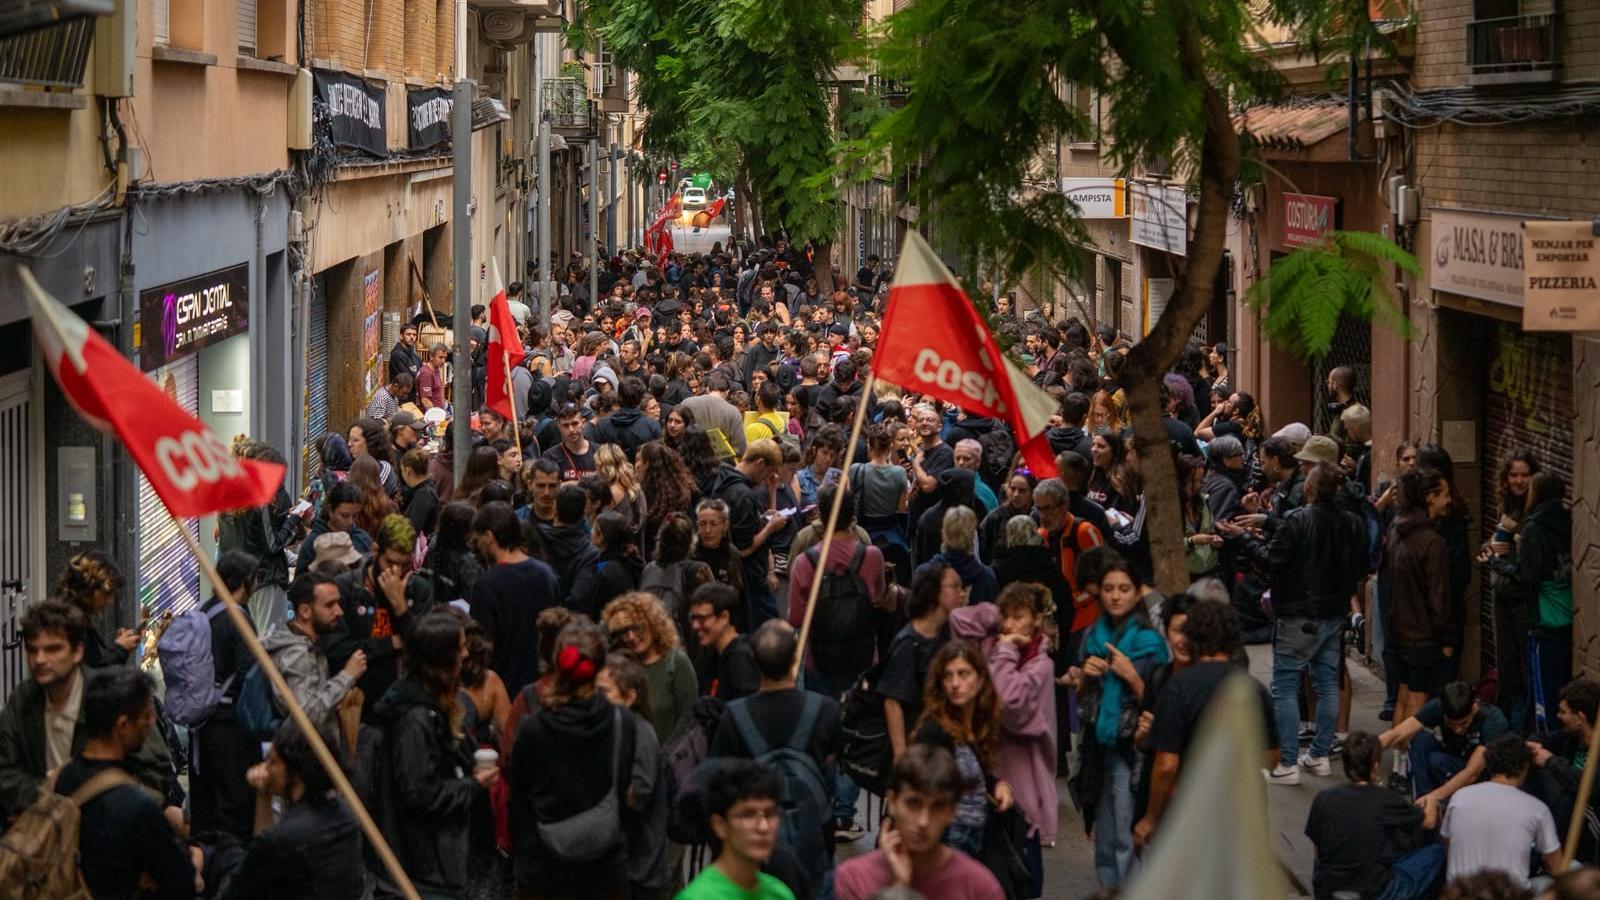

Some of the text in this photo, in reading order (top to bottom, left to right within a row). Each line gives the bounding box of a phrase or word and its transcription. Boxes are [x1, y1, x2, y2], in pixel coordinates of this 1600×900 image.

[1453, 226, 1486, 264] MASA
[1489, 229, 1499, 266] &
[1532, 240, 1594, 249] MENJAR PER
[1536, 253, 1589, 262] EMPORTAR
[1529, 277, 1597, 289] PIZZERIA
